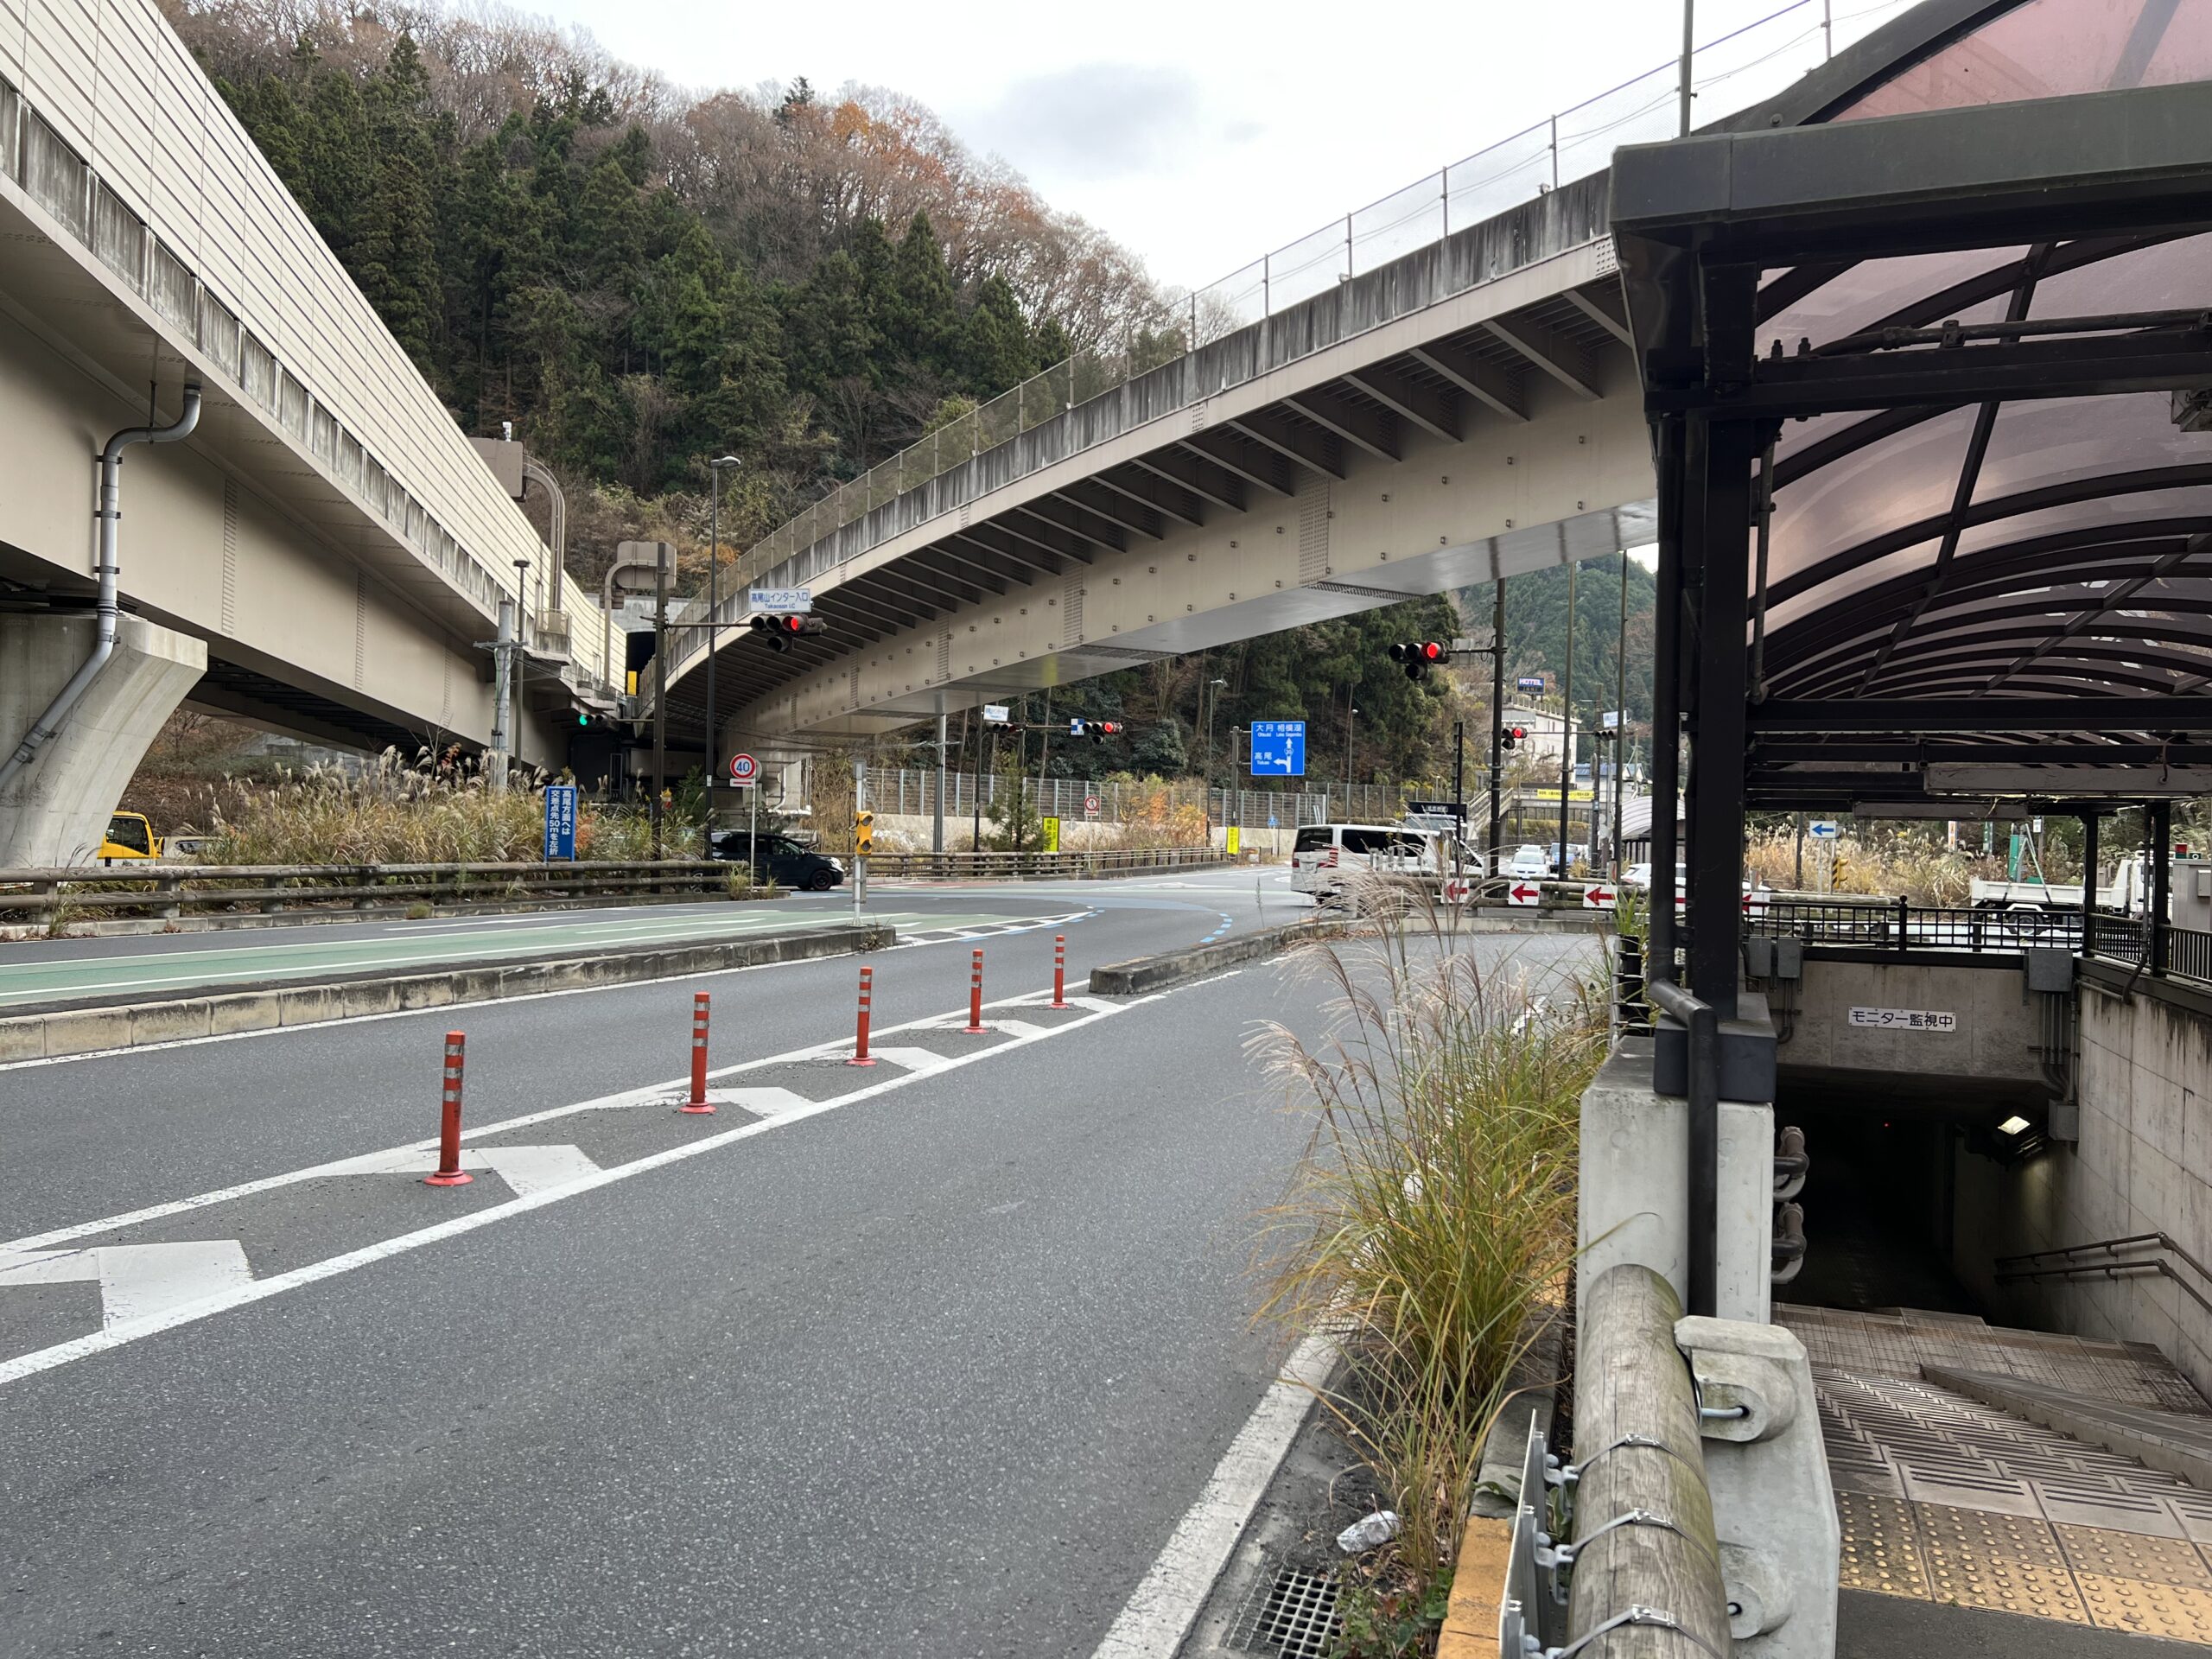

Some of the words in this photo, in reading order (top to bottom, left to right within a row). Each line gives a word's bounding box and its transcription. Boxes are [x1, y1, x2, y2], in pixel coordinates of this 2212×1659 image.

[751, 592, 808, 602] 高尾山インター入口
[1519, 677, 1543, 686] HOTEL
[1255, 723, 1274, 733] 大月
[1254, 752, 1273, 760] 高尾
[736, 761, 750, 772] 40
[562, 790, 572, 836] 高尾方面へは
[549, 790, 560, 855] 交差点先50mを左折
[1853, 1011, 1953, 1027] モニター監視中
